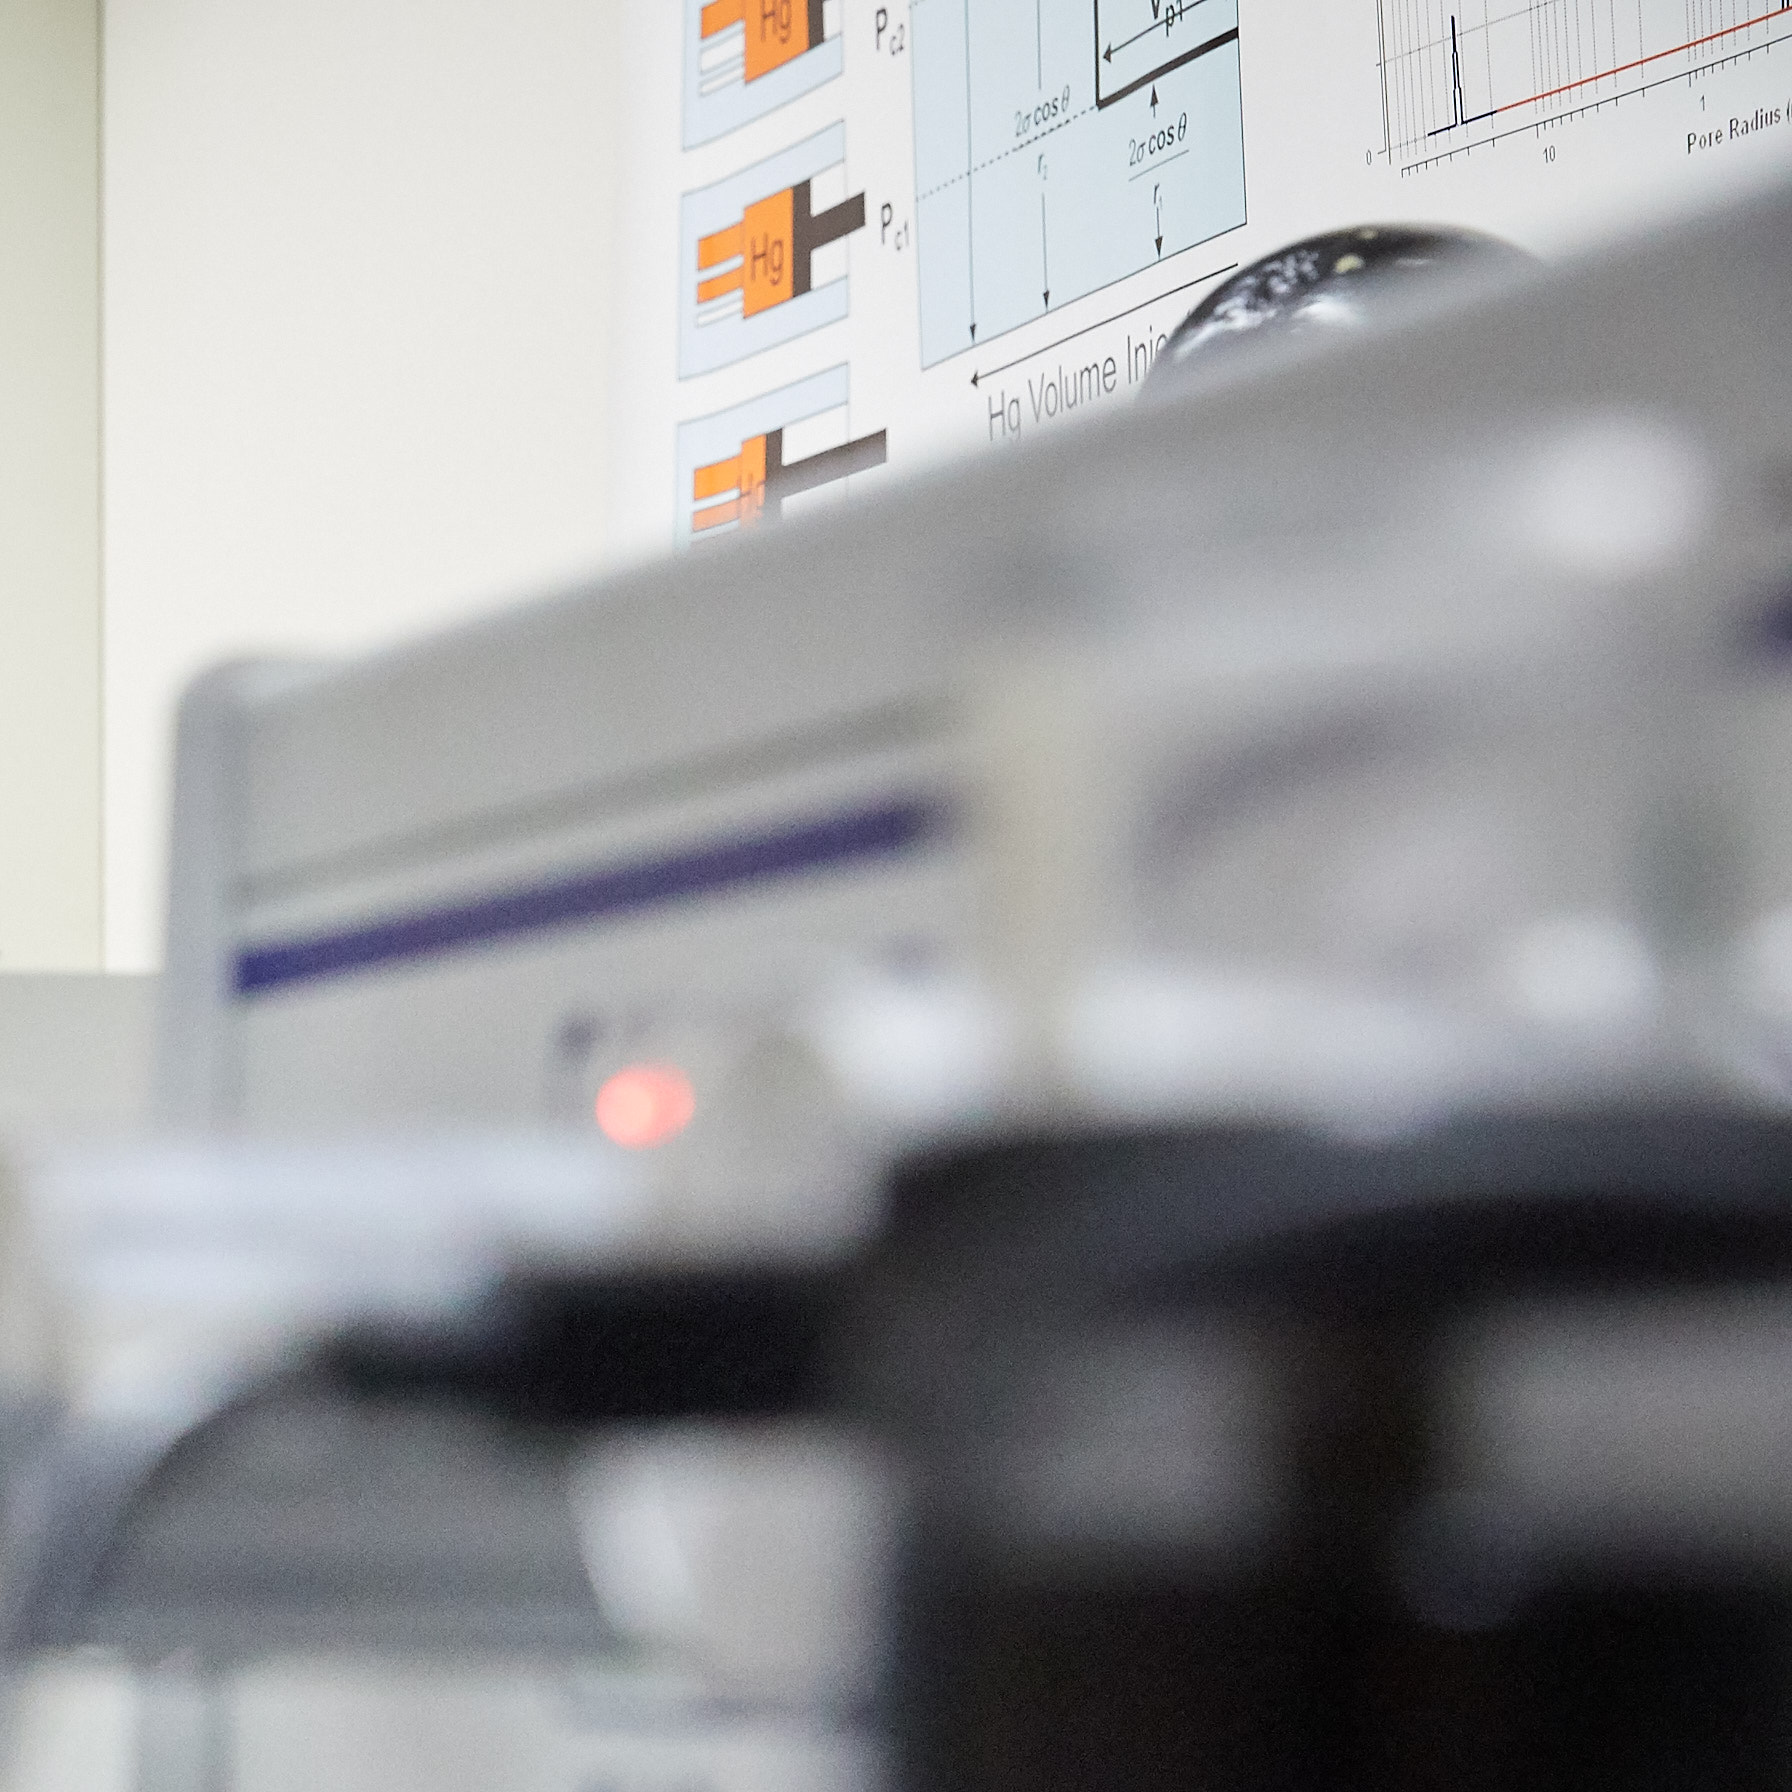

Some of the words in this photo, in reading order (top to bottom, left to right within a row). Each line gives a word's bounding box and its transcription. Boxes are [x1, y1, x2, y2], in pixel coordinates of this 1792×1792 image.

[760, 0, 793, 44] Hg
[1700, 94, 1706, 112] 1
[1686, 131, 1724, 155] Pore
[1728, 107, 1782, 140] Radius
[1365, 150, 1373, 166] 0
[1542, 145, 1557, 164] 10
[751, 232, 785, 287] Hg
[987, 388, 1022, 442] Hg
[1028, 356, 1117, 424] Volume
